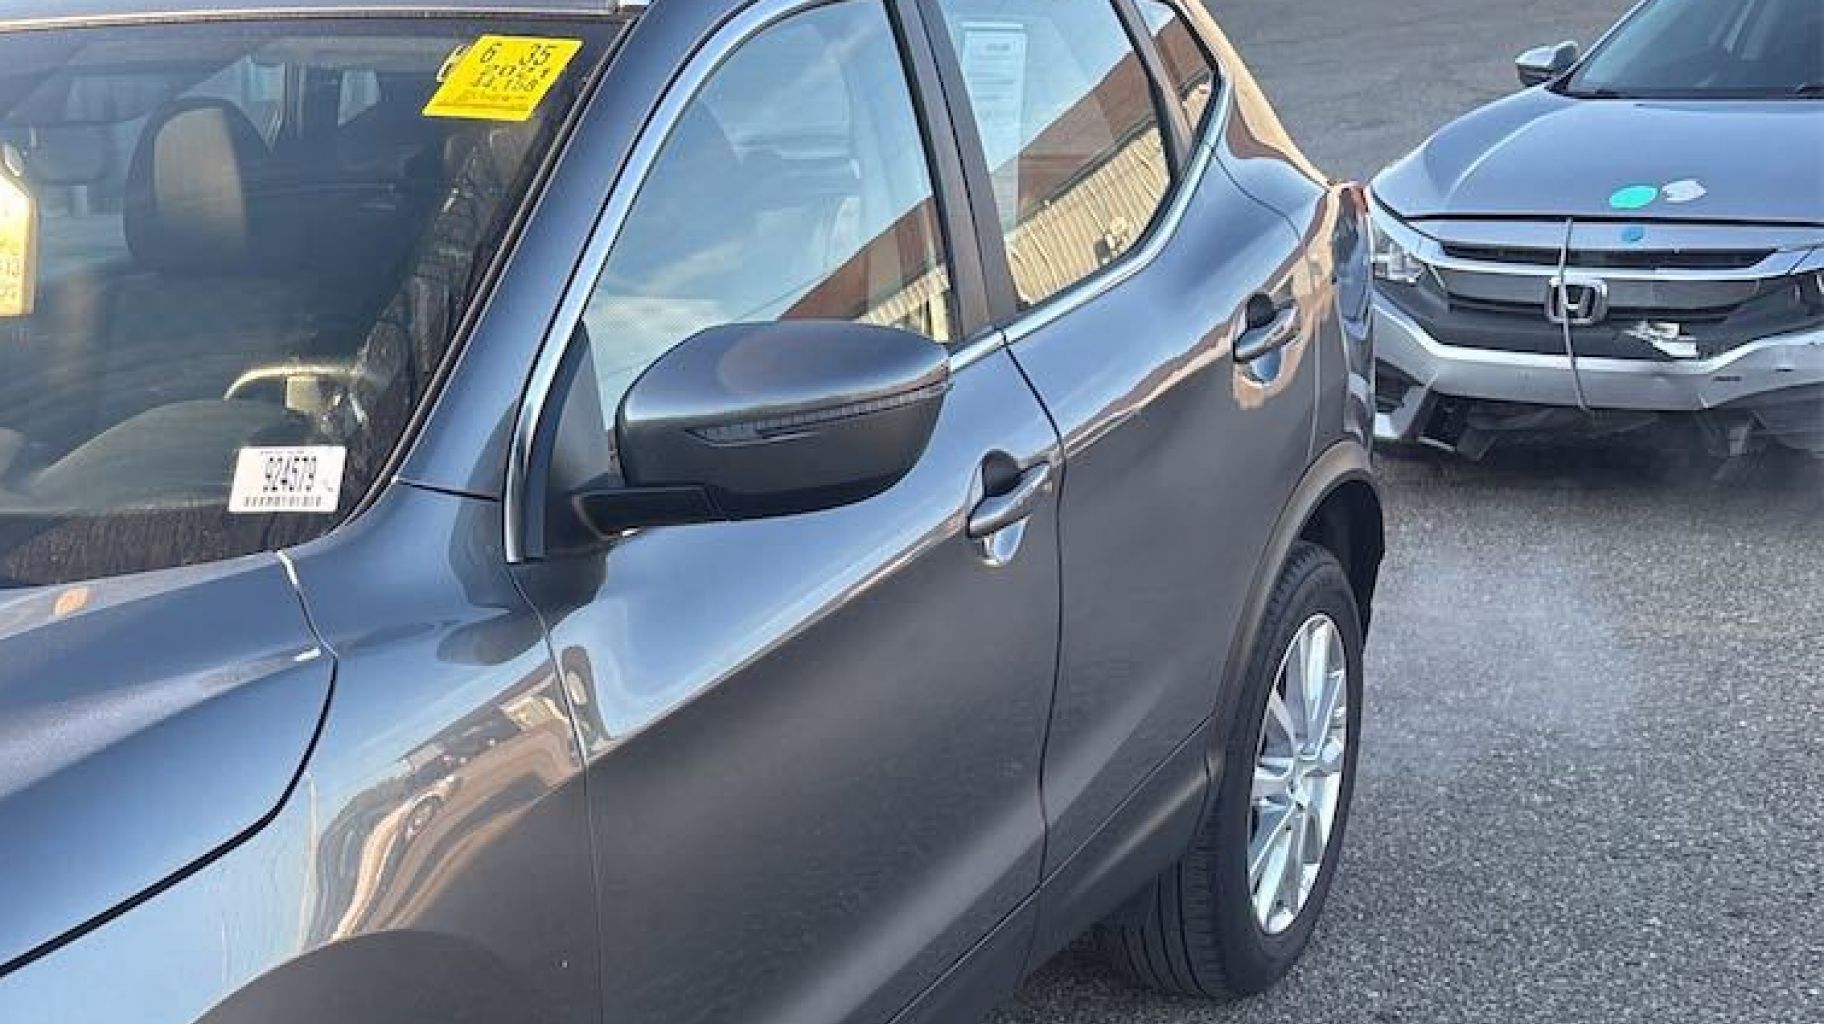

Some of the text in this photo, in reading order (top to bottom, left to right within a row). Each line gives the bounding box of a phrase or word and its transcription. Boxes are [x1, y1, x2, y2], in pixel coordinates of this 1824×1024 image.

[479, 42, 558, 66] 6 35
[263, 456, 317, 493] 924579
